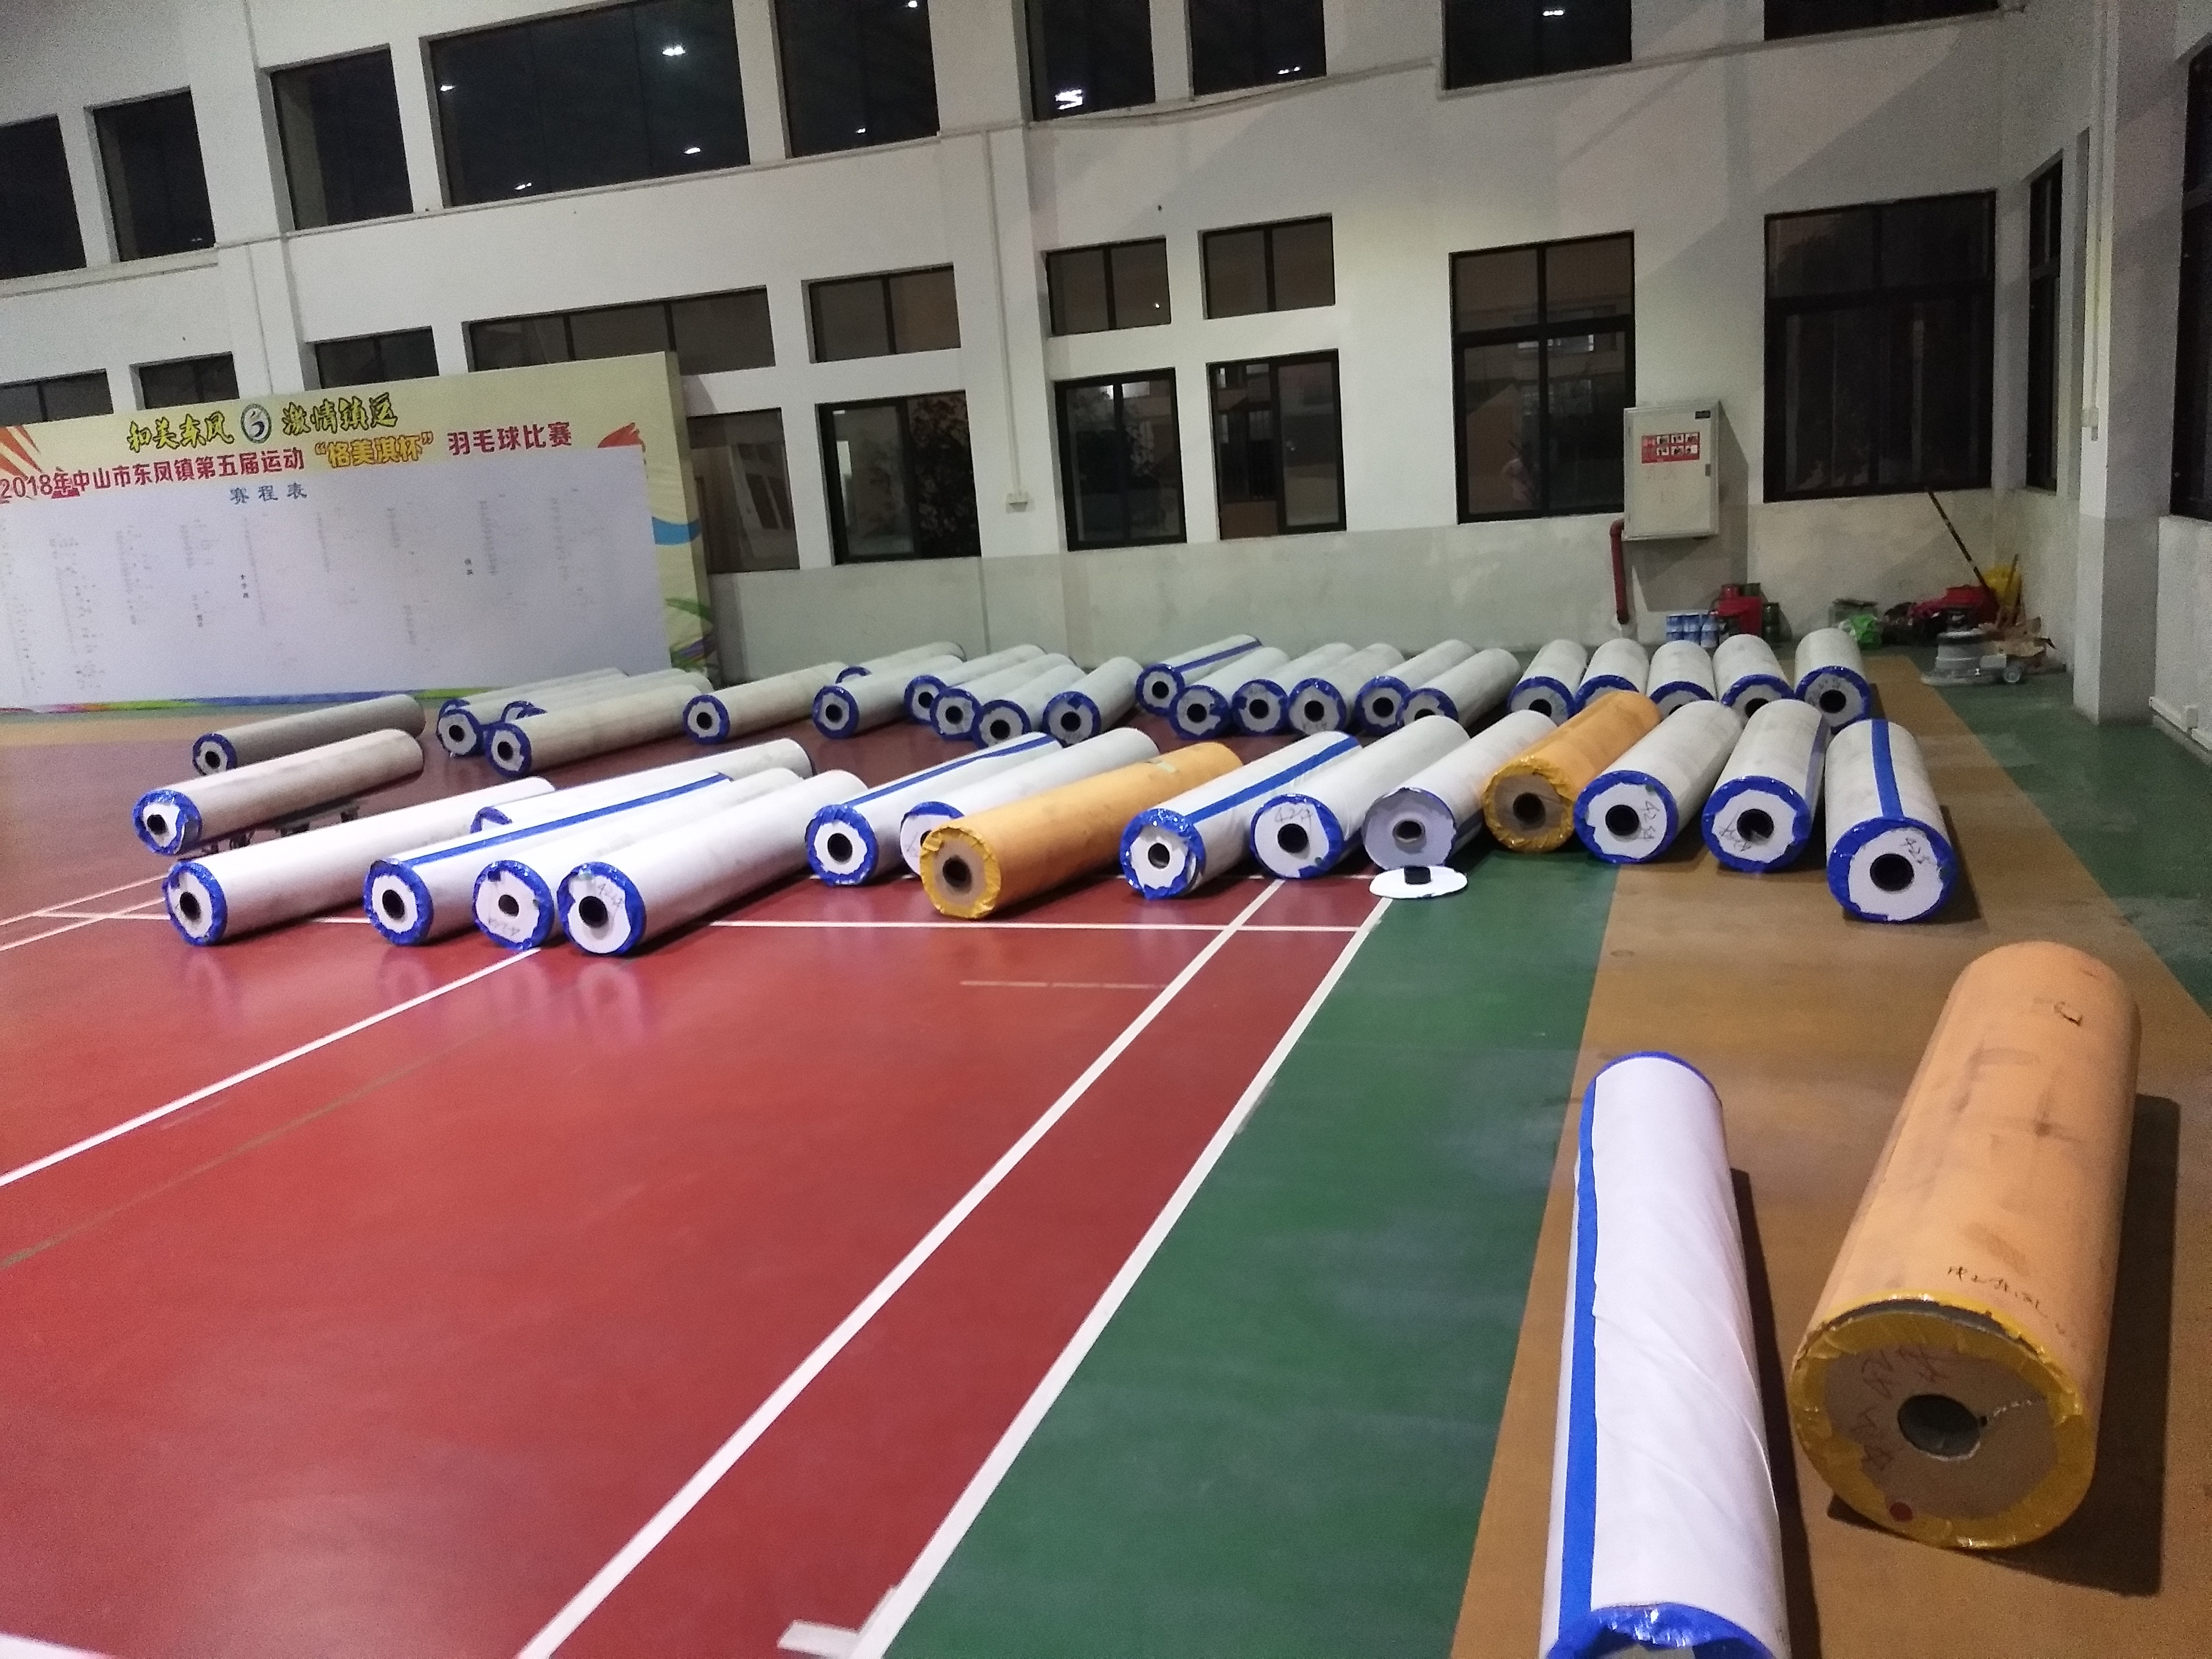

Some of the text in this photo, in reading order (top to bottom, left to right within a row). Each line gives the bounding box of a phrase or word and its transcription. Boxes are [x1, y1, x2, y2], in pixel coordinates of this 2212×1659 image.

[447, 421, 572, 456] 羽毛球比赛
